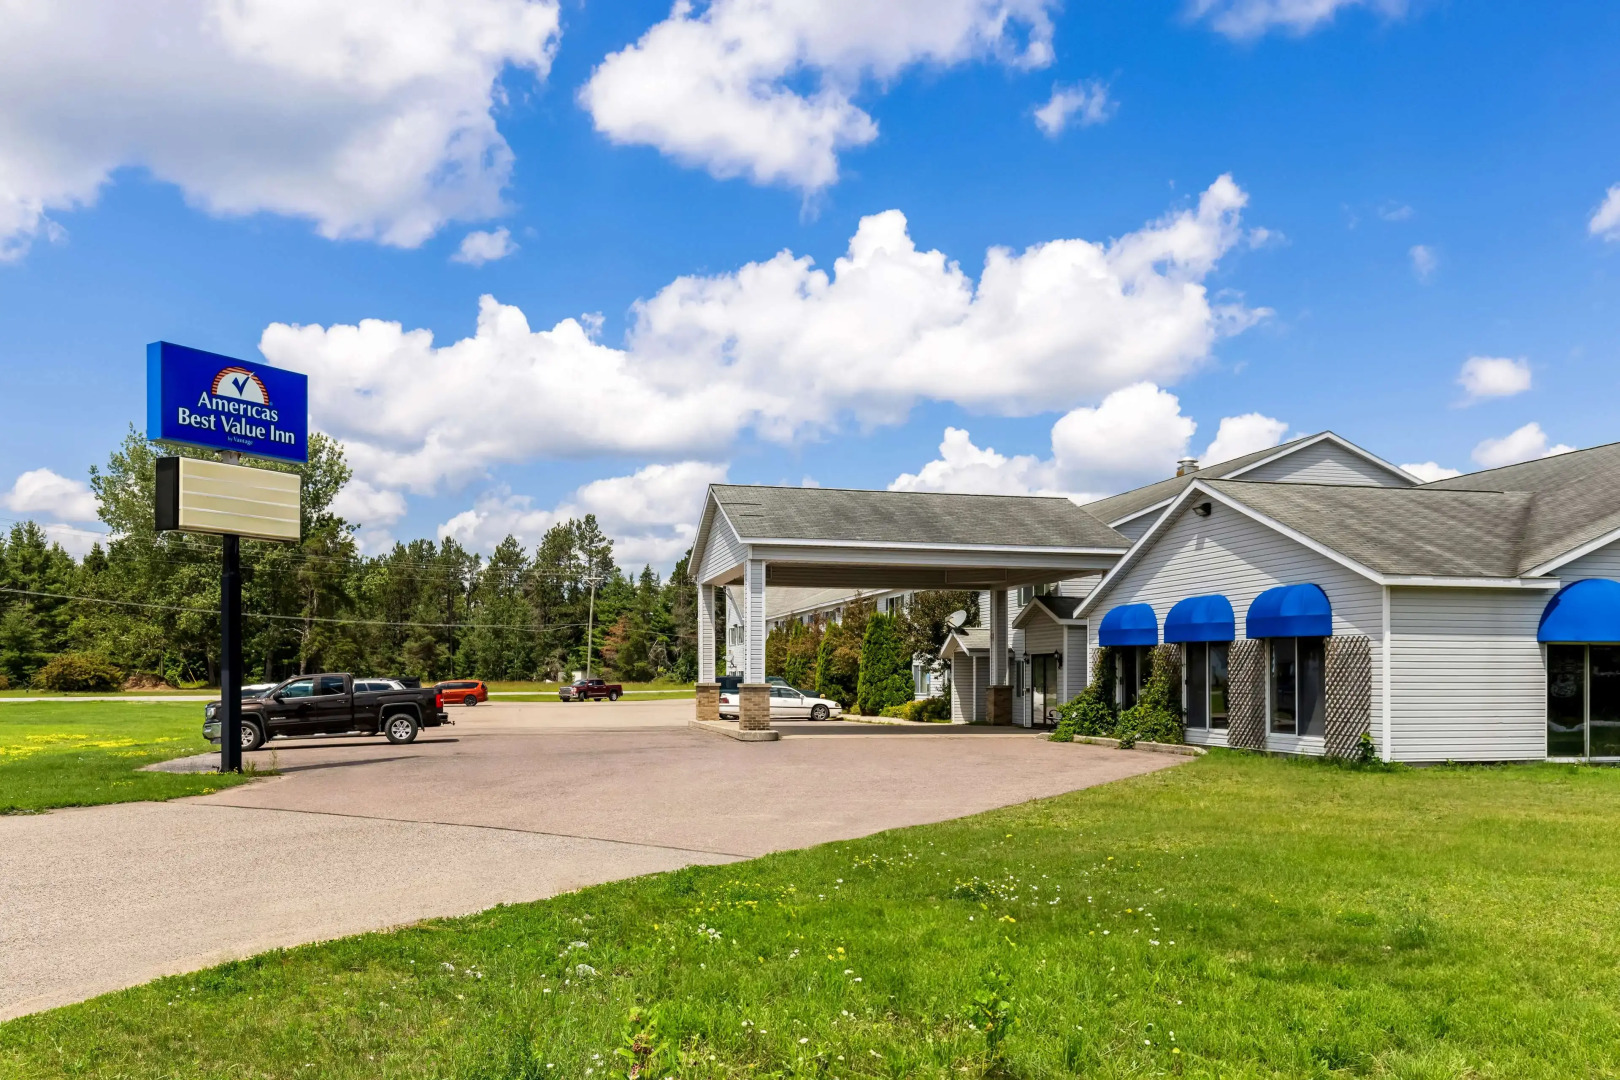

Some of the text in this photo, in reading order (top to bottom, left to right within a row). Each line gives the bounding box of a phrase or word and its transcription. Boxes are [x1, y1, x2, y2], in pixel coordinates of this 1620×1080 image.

[197, 391, 279, 422] Americas
[178, 406, 295, 445] Best Value Inn
